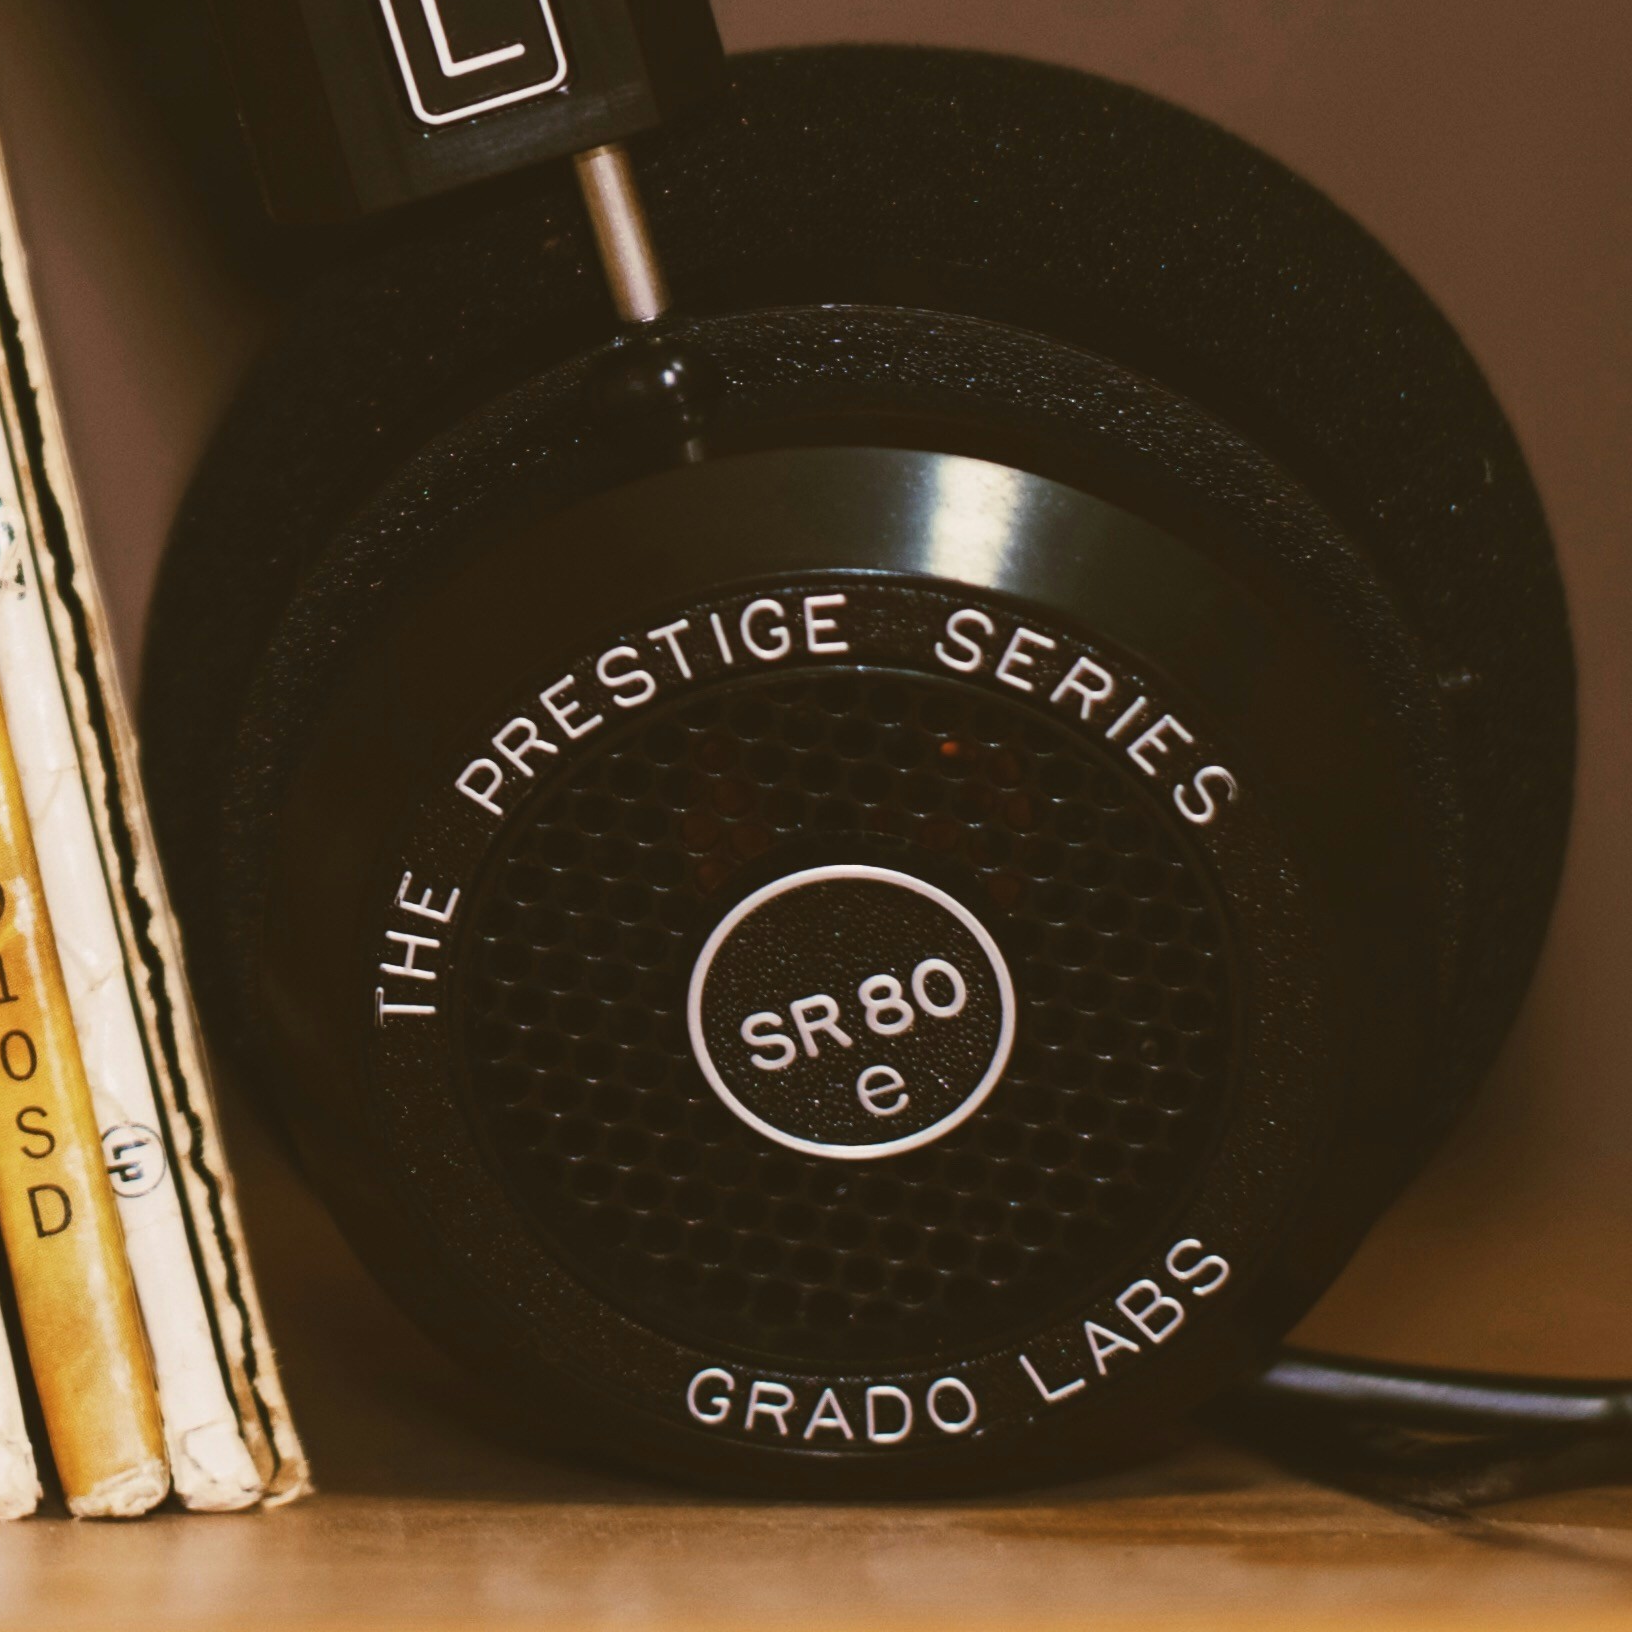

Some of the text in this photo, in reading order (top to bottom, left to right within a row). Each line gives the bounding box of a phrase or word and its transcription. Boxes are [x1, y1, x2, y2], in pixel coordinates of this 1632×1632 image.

[378, 594, 1239, 1028] THE PRESTIGE SERIES
[686, 1236, 1231, 1444] GRADO LABS
